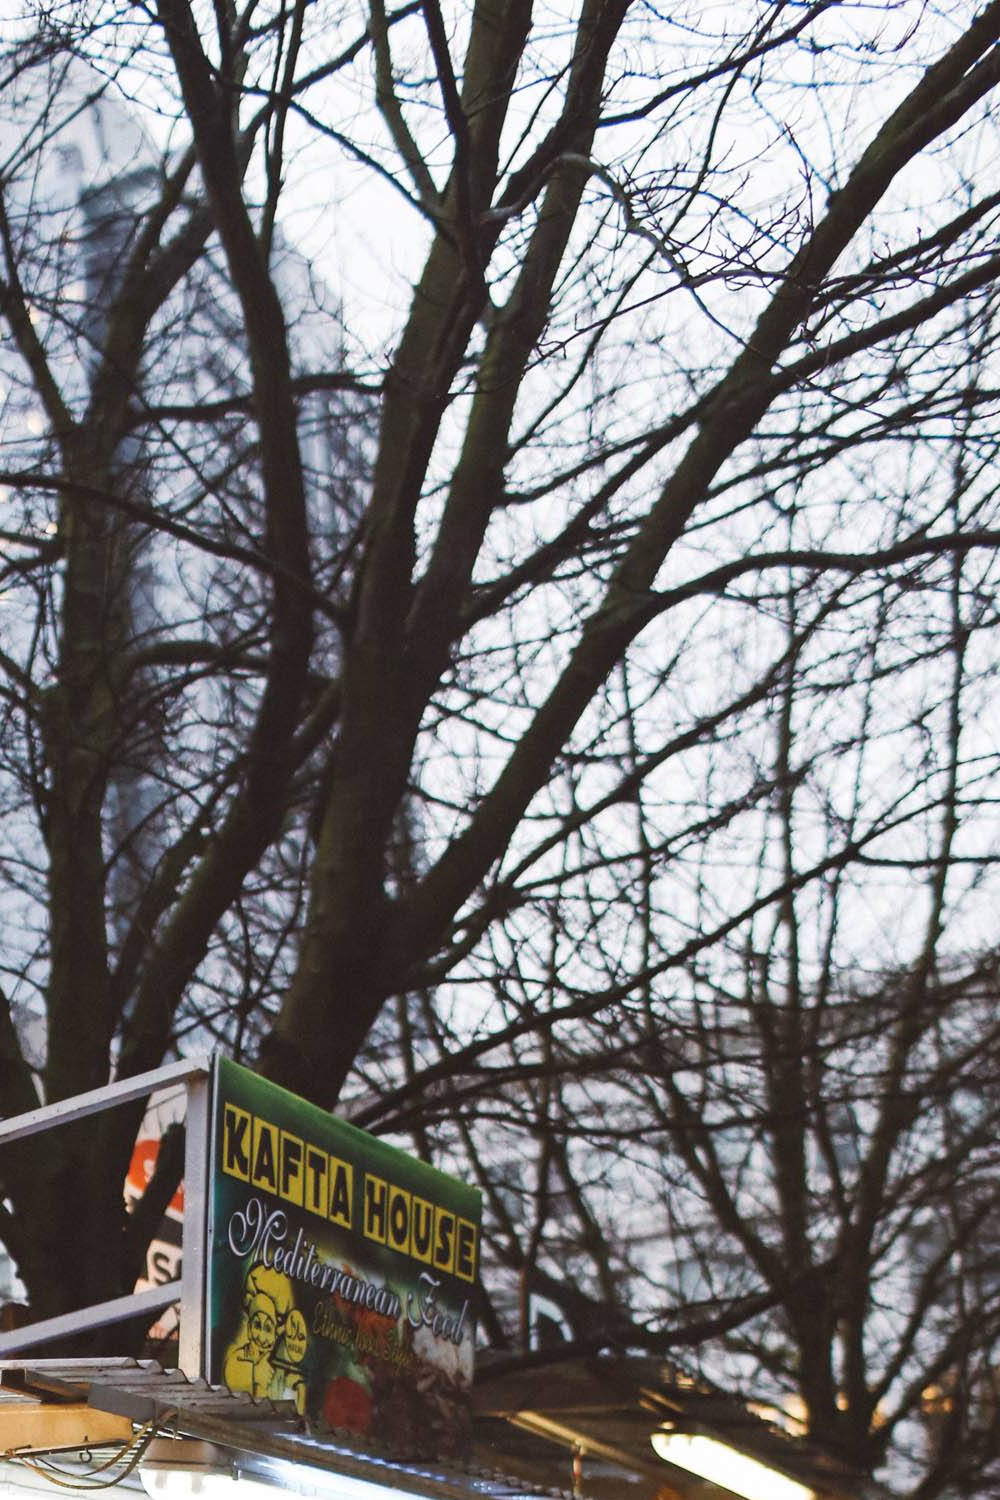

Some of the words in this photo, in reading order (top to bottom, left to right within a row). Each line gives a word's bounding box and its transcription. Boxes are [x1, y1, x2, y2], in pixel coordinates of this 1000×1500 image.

[225, 1108, 351, 1224] KAFTA
[366, 1175, 475, 1278] HOUSE
[228, 1198, 400, 1316] Mediterranean
[407, 1271, 469, 1345] Food
